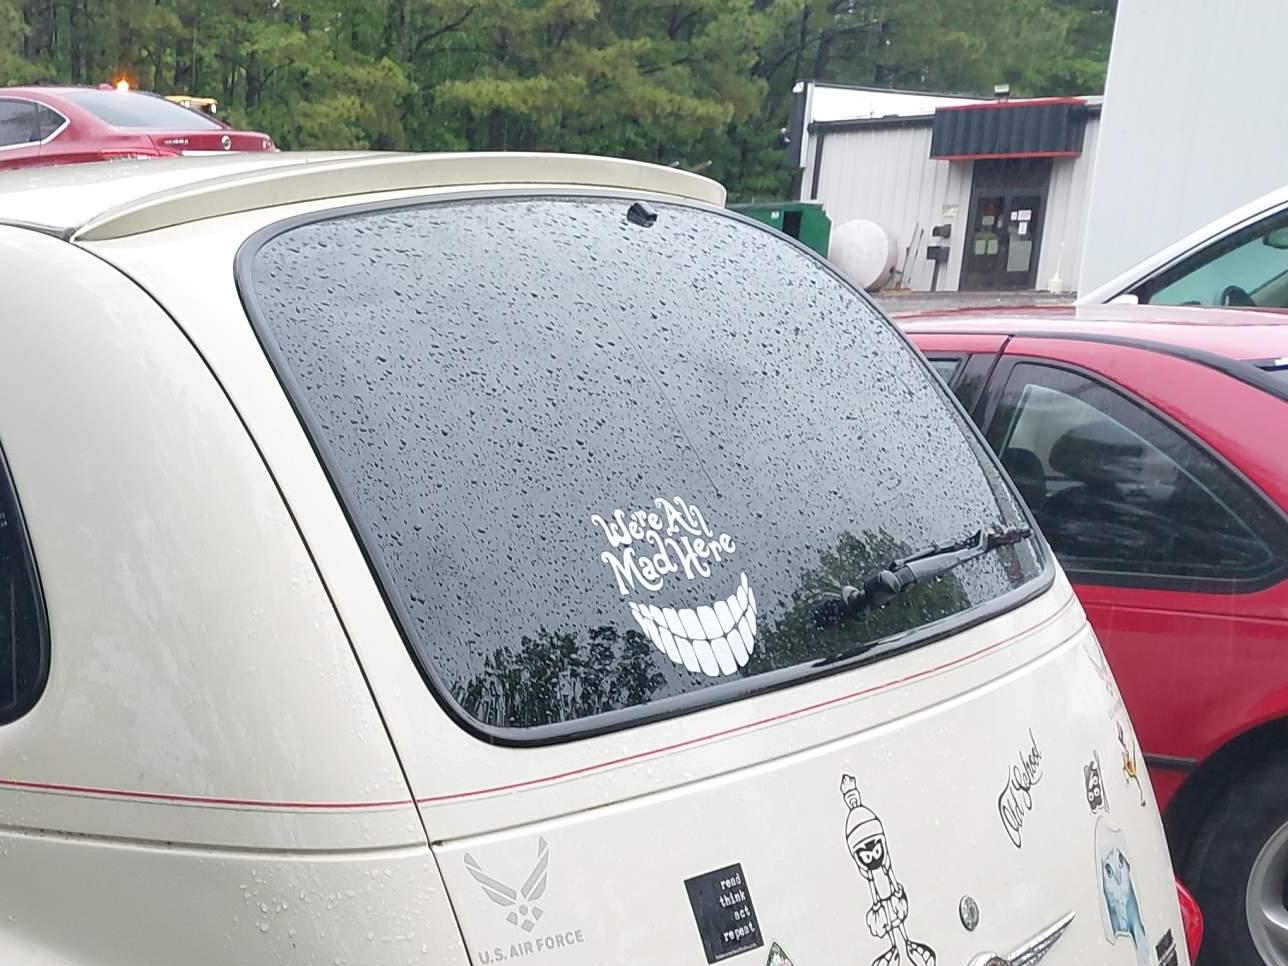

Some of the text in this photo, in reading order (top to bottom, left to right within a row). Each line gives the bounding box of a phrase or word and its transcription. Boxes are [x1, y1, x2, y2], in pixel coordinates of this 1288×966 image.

[654, 496, 713, 537] All
[601, 530, 736, 595] Mad Here
[719, 888, 747, 908] think
[734, 904, 751, 921] act
[723, 920, 755, 943] repeat
[478, 929, 585, 965] U.S. AIR FORCE
